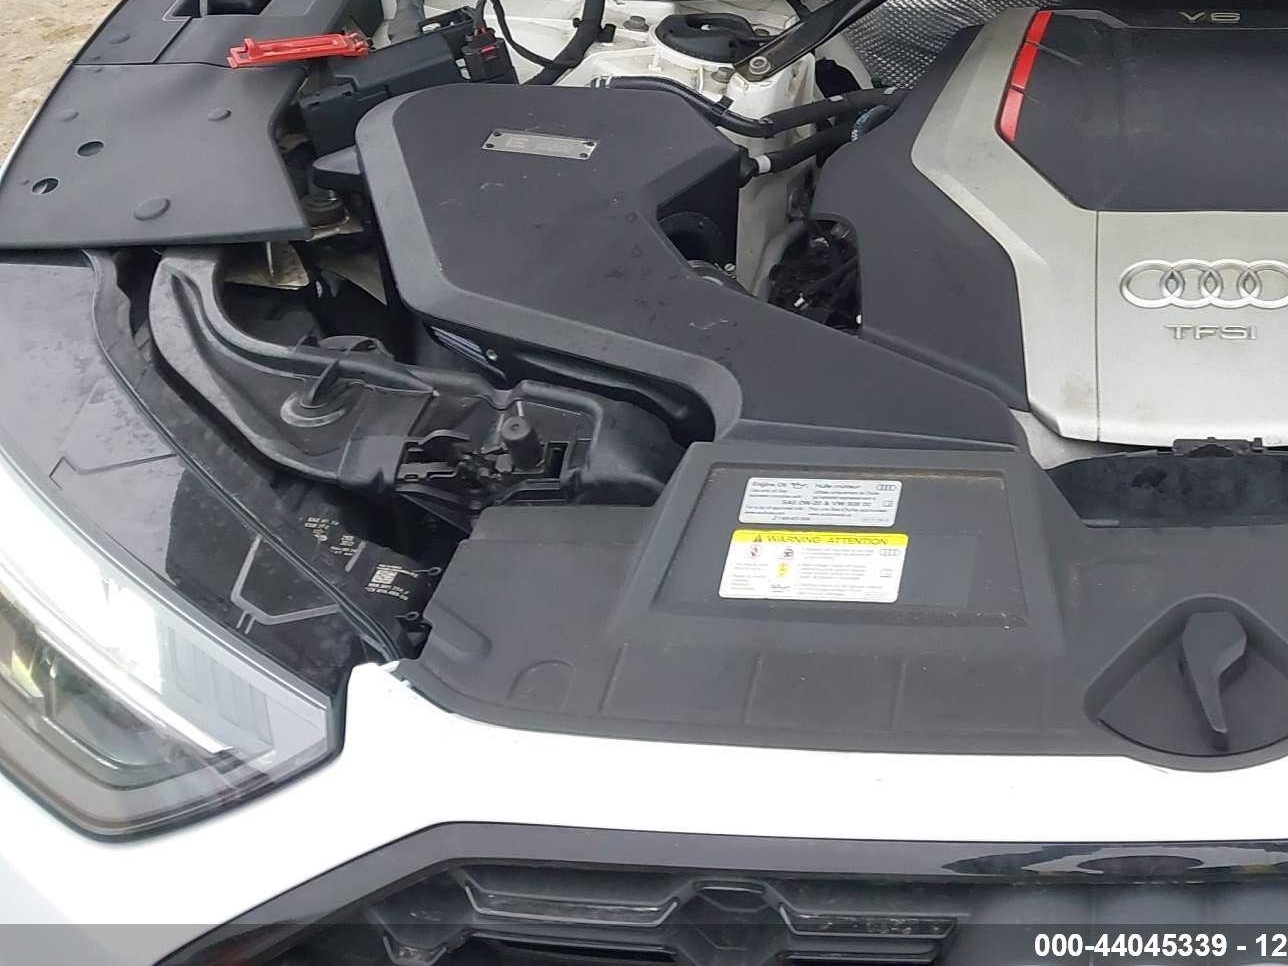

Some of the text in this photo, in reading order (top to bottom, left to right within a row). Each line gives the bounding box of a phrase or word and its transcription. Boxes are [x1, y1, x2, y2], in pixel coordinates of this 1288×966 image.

[1179, 10, 1242, 24] V6
[1166, 323, 1259, 341] TFSI
[766, 535, 888, 545] WARNING ATTENTION
